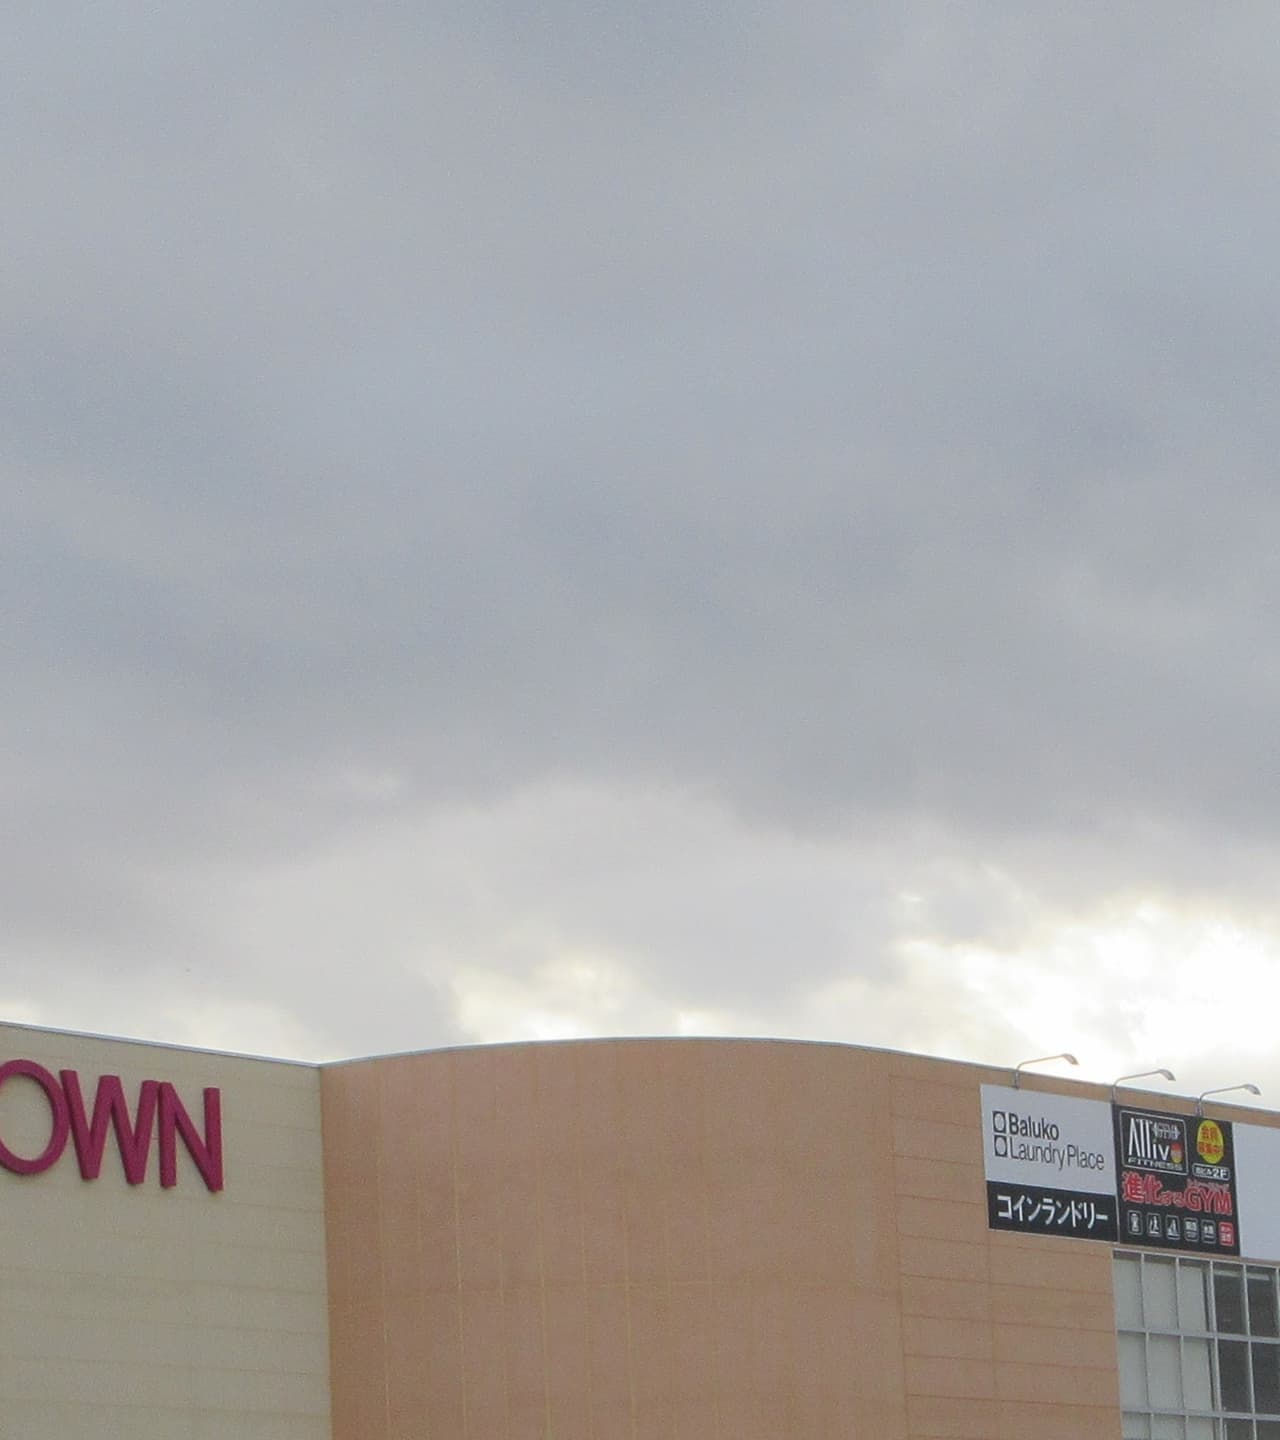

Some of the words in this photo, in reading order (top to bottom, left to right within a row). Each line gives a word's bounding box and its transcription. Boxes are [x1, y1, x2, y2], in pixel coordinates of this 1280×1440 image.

[1008, 1112, 1060, 1141] Baluko
[1010, 1138, 1065, 1171] Laundry
[1066, 1144, 1105, 1171] Place
[997, 1194, 1109, 1230] コインランドリー
